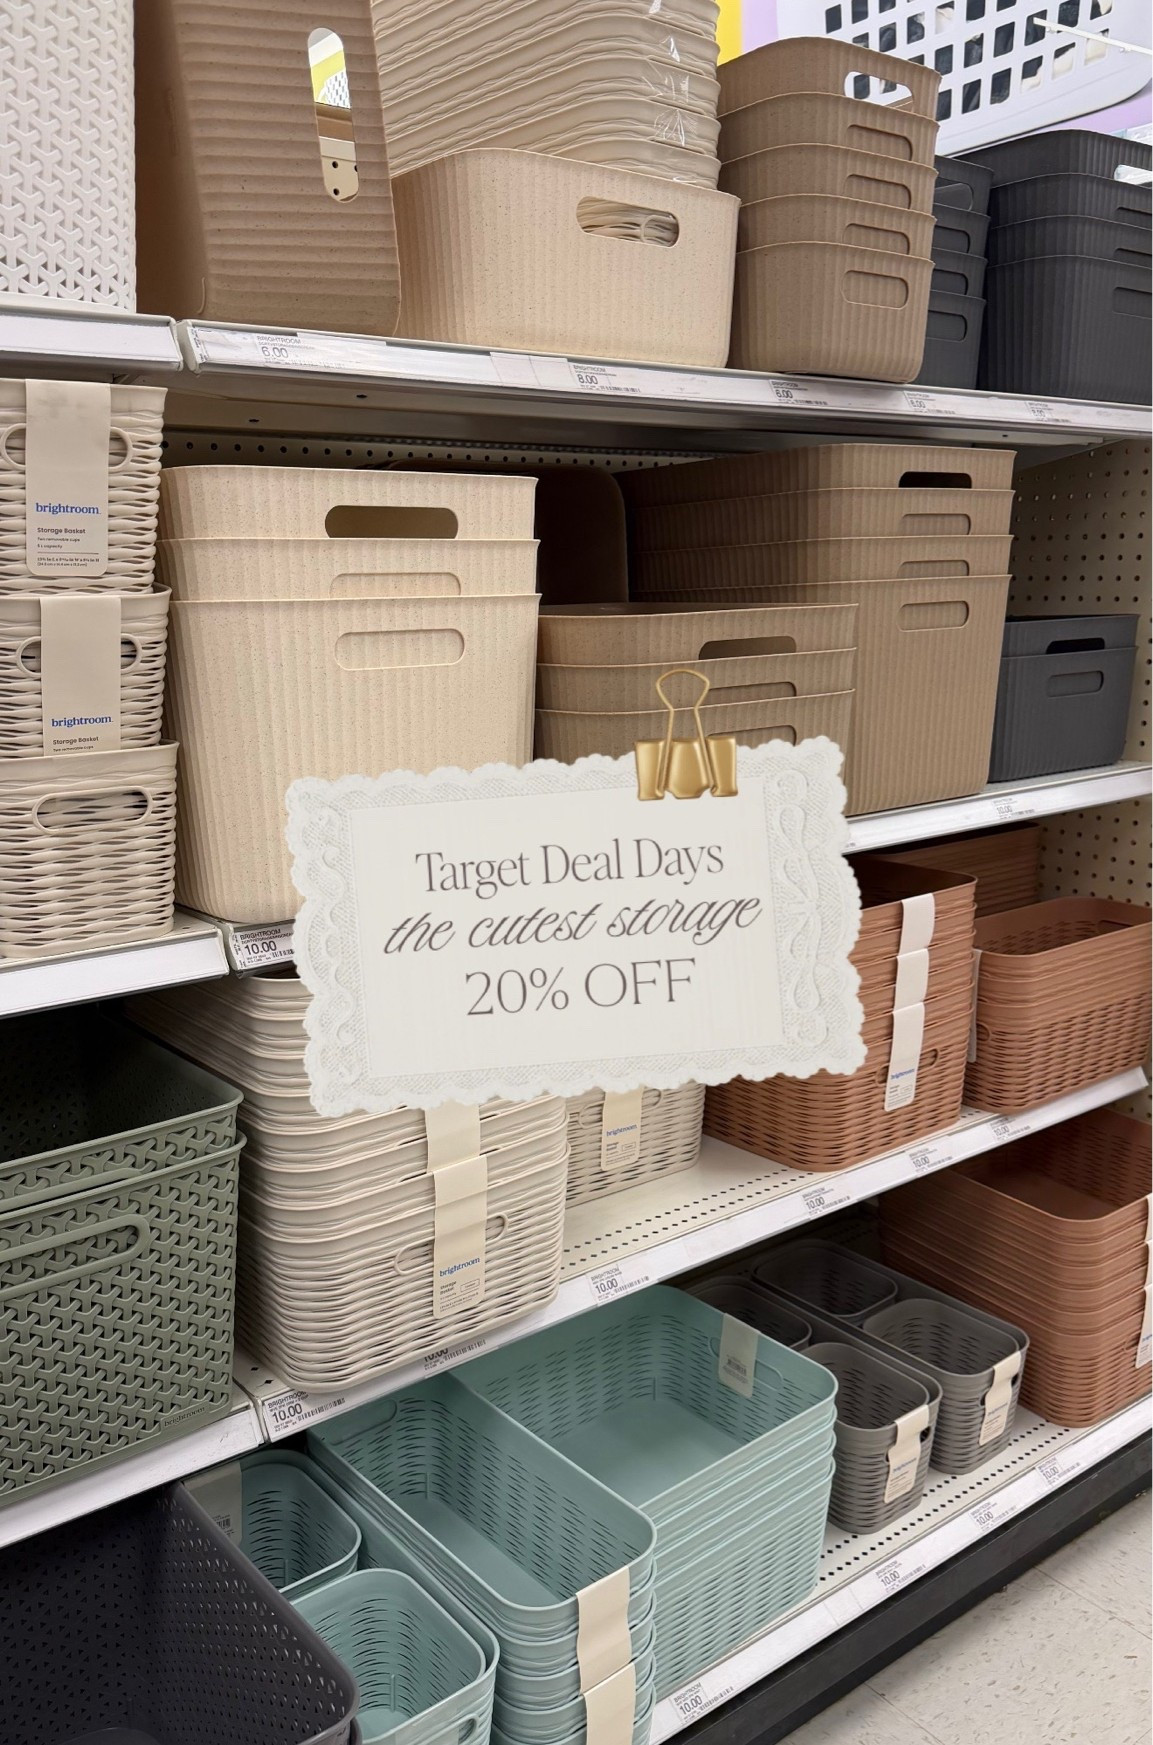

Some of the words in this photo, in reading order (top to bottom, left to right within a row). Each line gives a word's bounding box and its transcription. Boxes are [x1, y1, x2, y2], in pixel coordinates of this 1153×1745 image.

[261, 346, 289, 359] 6.00
[577, 374, 599, 385] 8.00
[35, 502, 101, 515] brightroom
[37, 527, 63, 535] Storage
[51, 715, 113, 728] brightroom
[240, 928, 281, 940] BRIGHTROOM
[244, 940, 277, 955] 10.00
[806, 1196, 826, 1210] 10.00
[439, 1257, 480, 1277] brightroom
[595, 1278, 619, 1294] 10.00
[164, 1407, 205, 1427] brightroom
[272, 1403, 303, 1423] 10.00
[881, 1570, 900, 1586] 10.00
[679, 1695, 703, 1715] 10.00
